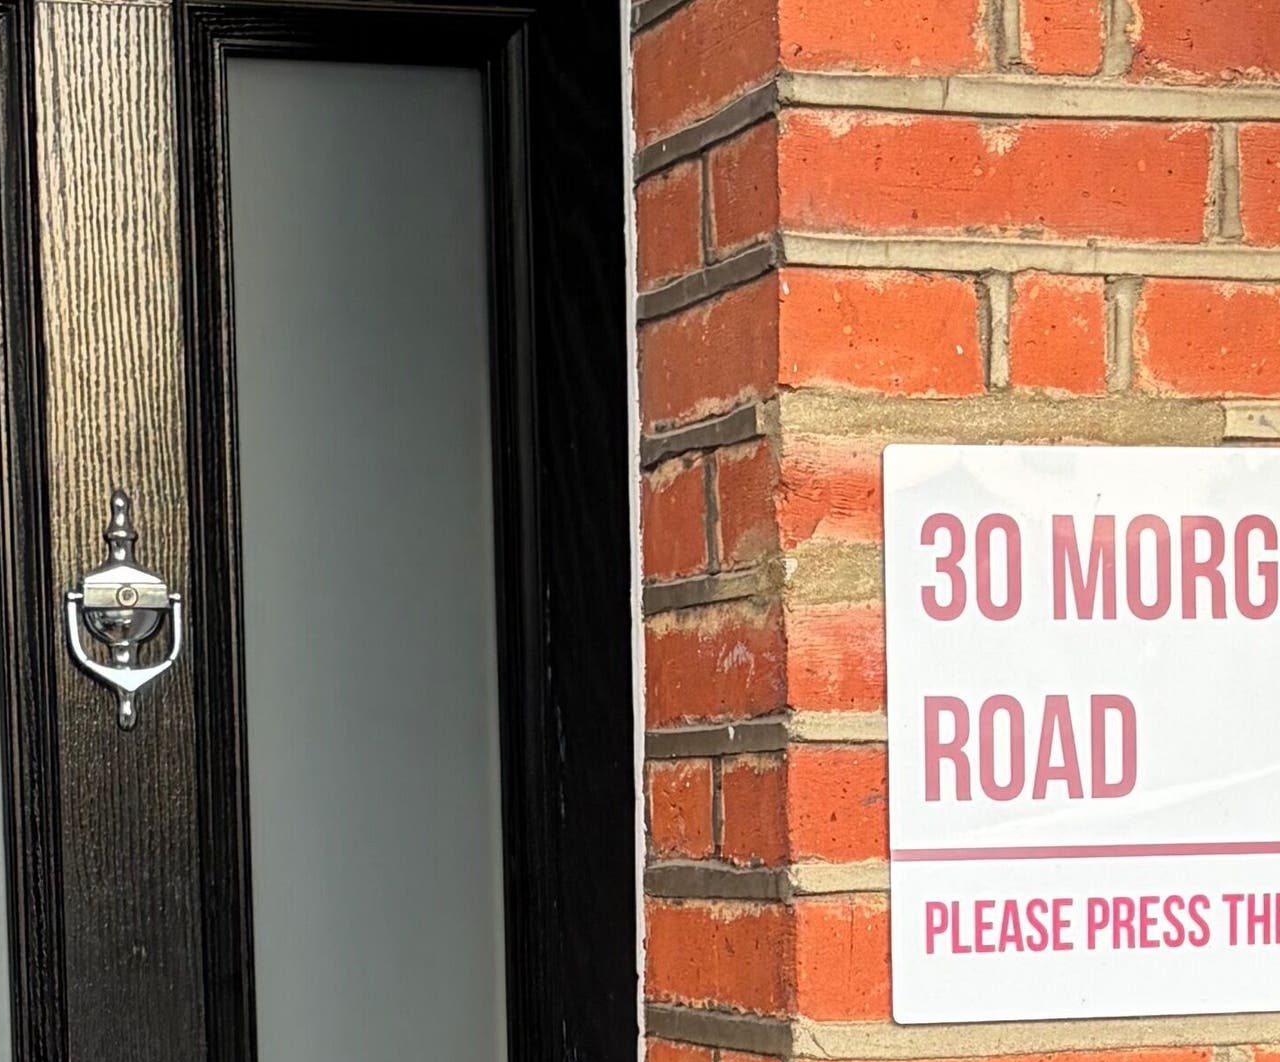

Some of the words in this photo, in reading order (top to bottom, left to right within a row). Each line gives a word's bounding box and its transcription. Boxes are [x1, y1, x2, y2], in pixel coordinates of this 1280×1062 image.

[921, 513, 1021, 621] 30
[923, 694, 1138, 802] ROAD
[925, 898, 1073, 954] PLEASE
[1087, 895, 1210, 949] PRESS
